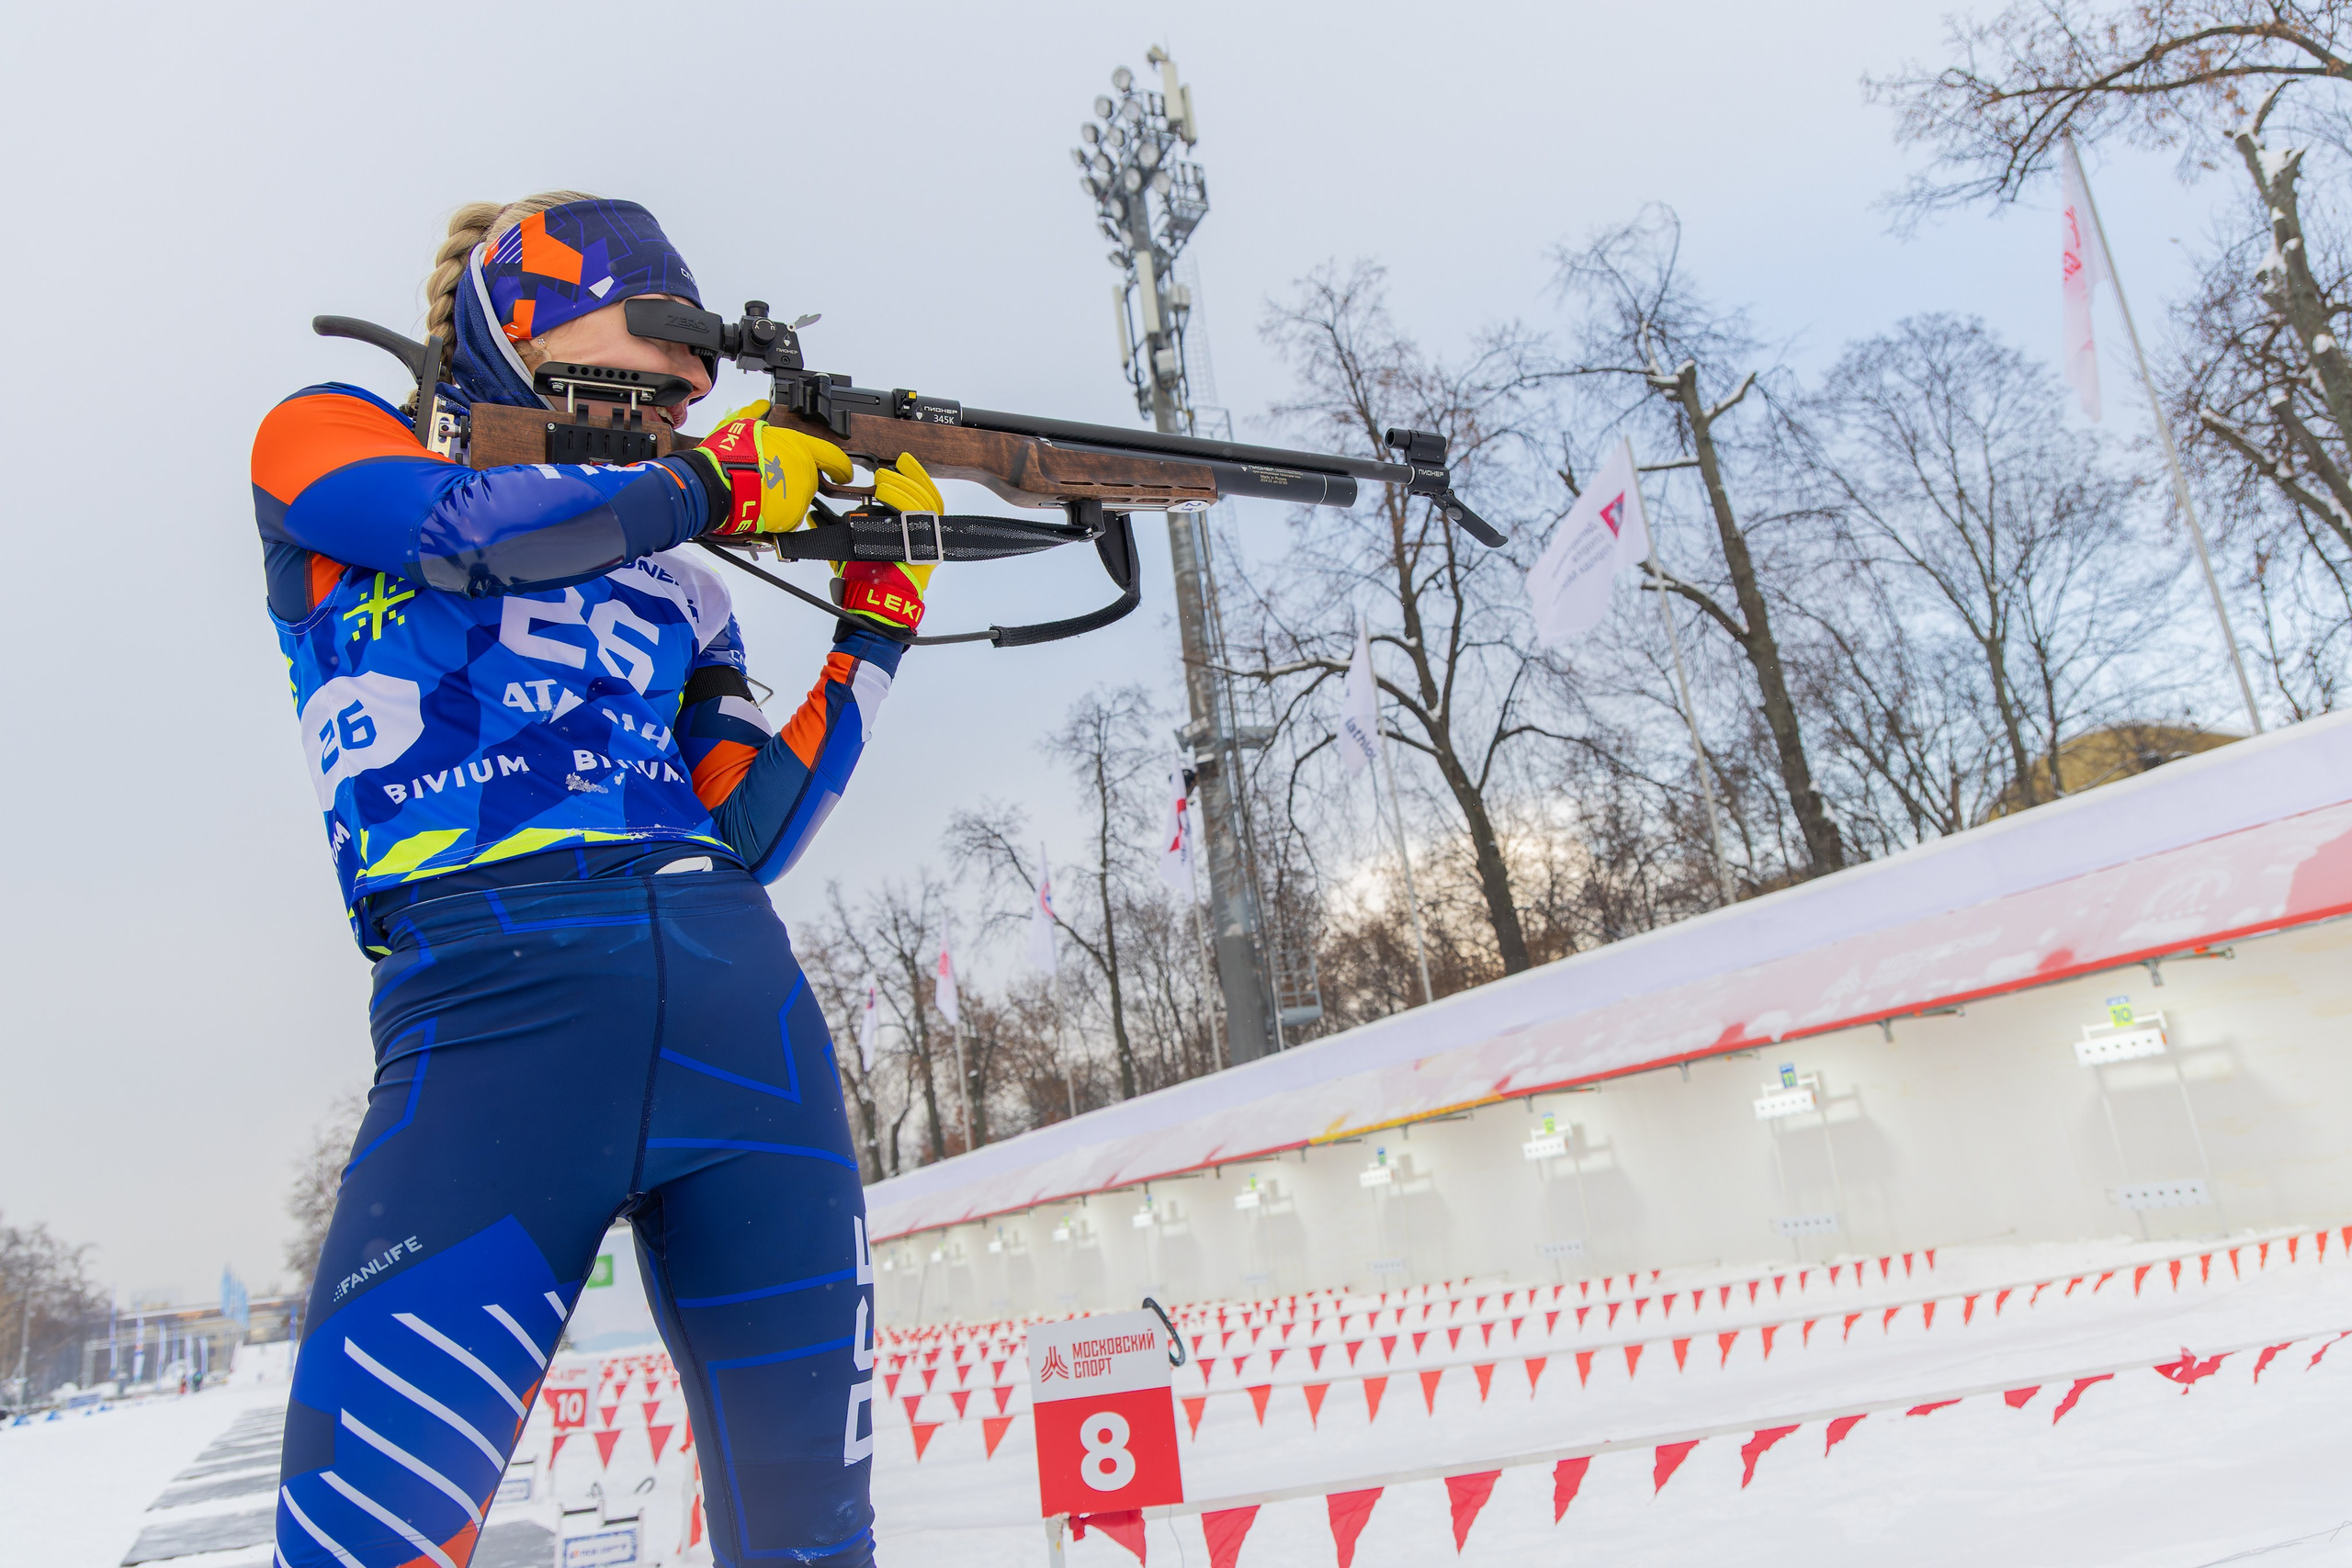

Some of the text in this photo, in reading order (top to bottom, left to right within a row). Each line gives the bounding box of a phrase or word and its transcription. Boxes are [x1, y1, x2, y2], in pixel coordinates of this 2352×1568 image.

[666, 315, 709, 332] ZERO
[775, 347, 799, 355] ПИОНЕР
[923, 405, 958, 414] ПИОНЕР
[718, 418, 756, 451] EKI
[1418, 468, 1444, 478] ПИОНЕР
[866, 589, 922, 624] LEKI
[319, 699, 378, 775] 26
[383, 754, 530, 805] BIVIUM
[2112, 1007, 2133, 1023] 10
[340, 1235, 423, 1295] FANLIFE
[1072, 1328, 1156, 1360] МОСКОВСКИЙ
[1074, 1358, 1112, 1380] СПОРТ
[557, 1392, 585, 1424] 10
[1080, 1411, 1136, 1492] 8
